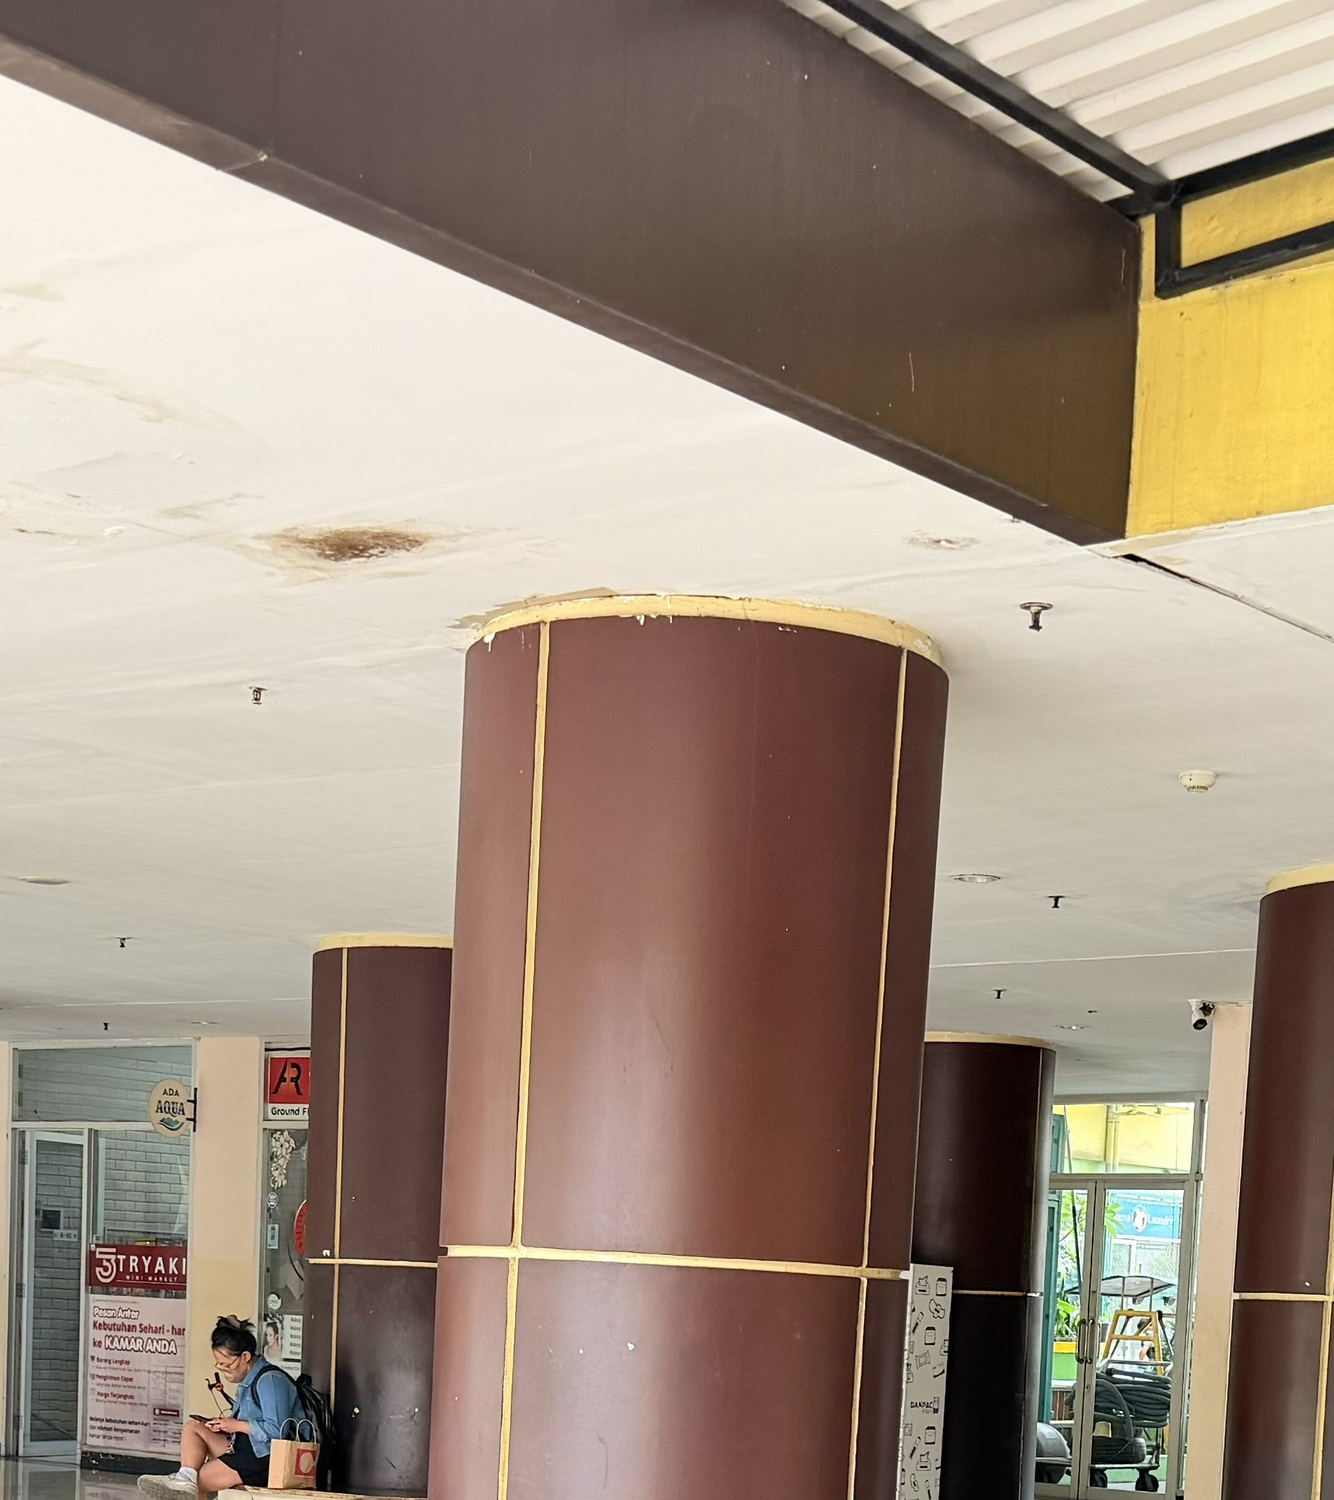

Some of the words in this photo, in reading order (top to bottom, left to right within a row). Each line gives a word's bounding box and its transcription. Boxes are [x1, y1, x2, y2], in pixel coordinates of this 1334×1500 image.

[162, 1088, 180, 1097] ADA
[155, 1099, 186, 1117] AQUA
[271, 1107, 300, 1116] Ground
[117, 1254, 186, 1275] TRYAKI
[93, 1306, 116, 1318] Pesan
[117, 1307, 140, 1319] Antar
[93, 1320, 137, 1333] Kebutuhan
[139, 1323, 165, 1335] Sehari
[93, 1338, 103, 1348] ke
[105, 1335, 144, 1353] KAMAR
[145, 1337, 178, 1355] ANDA
